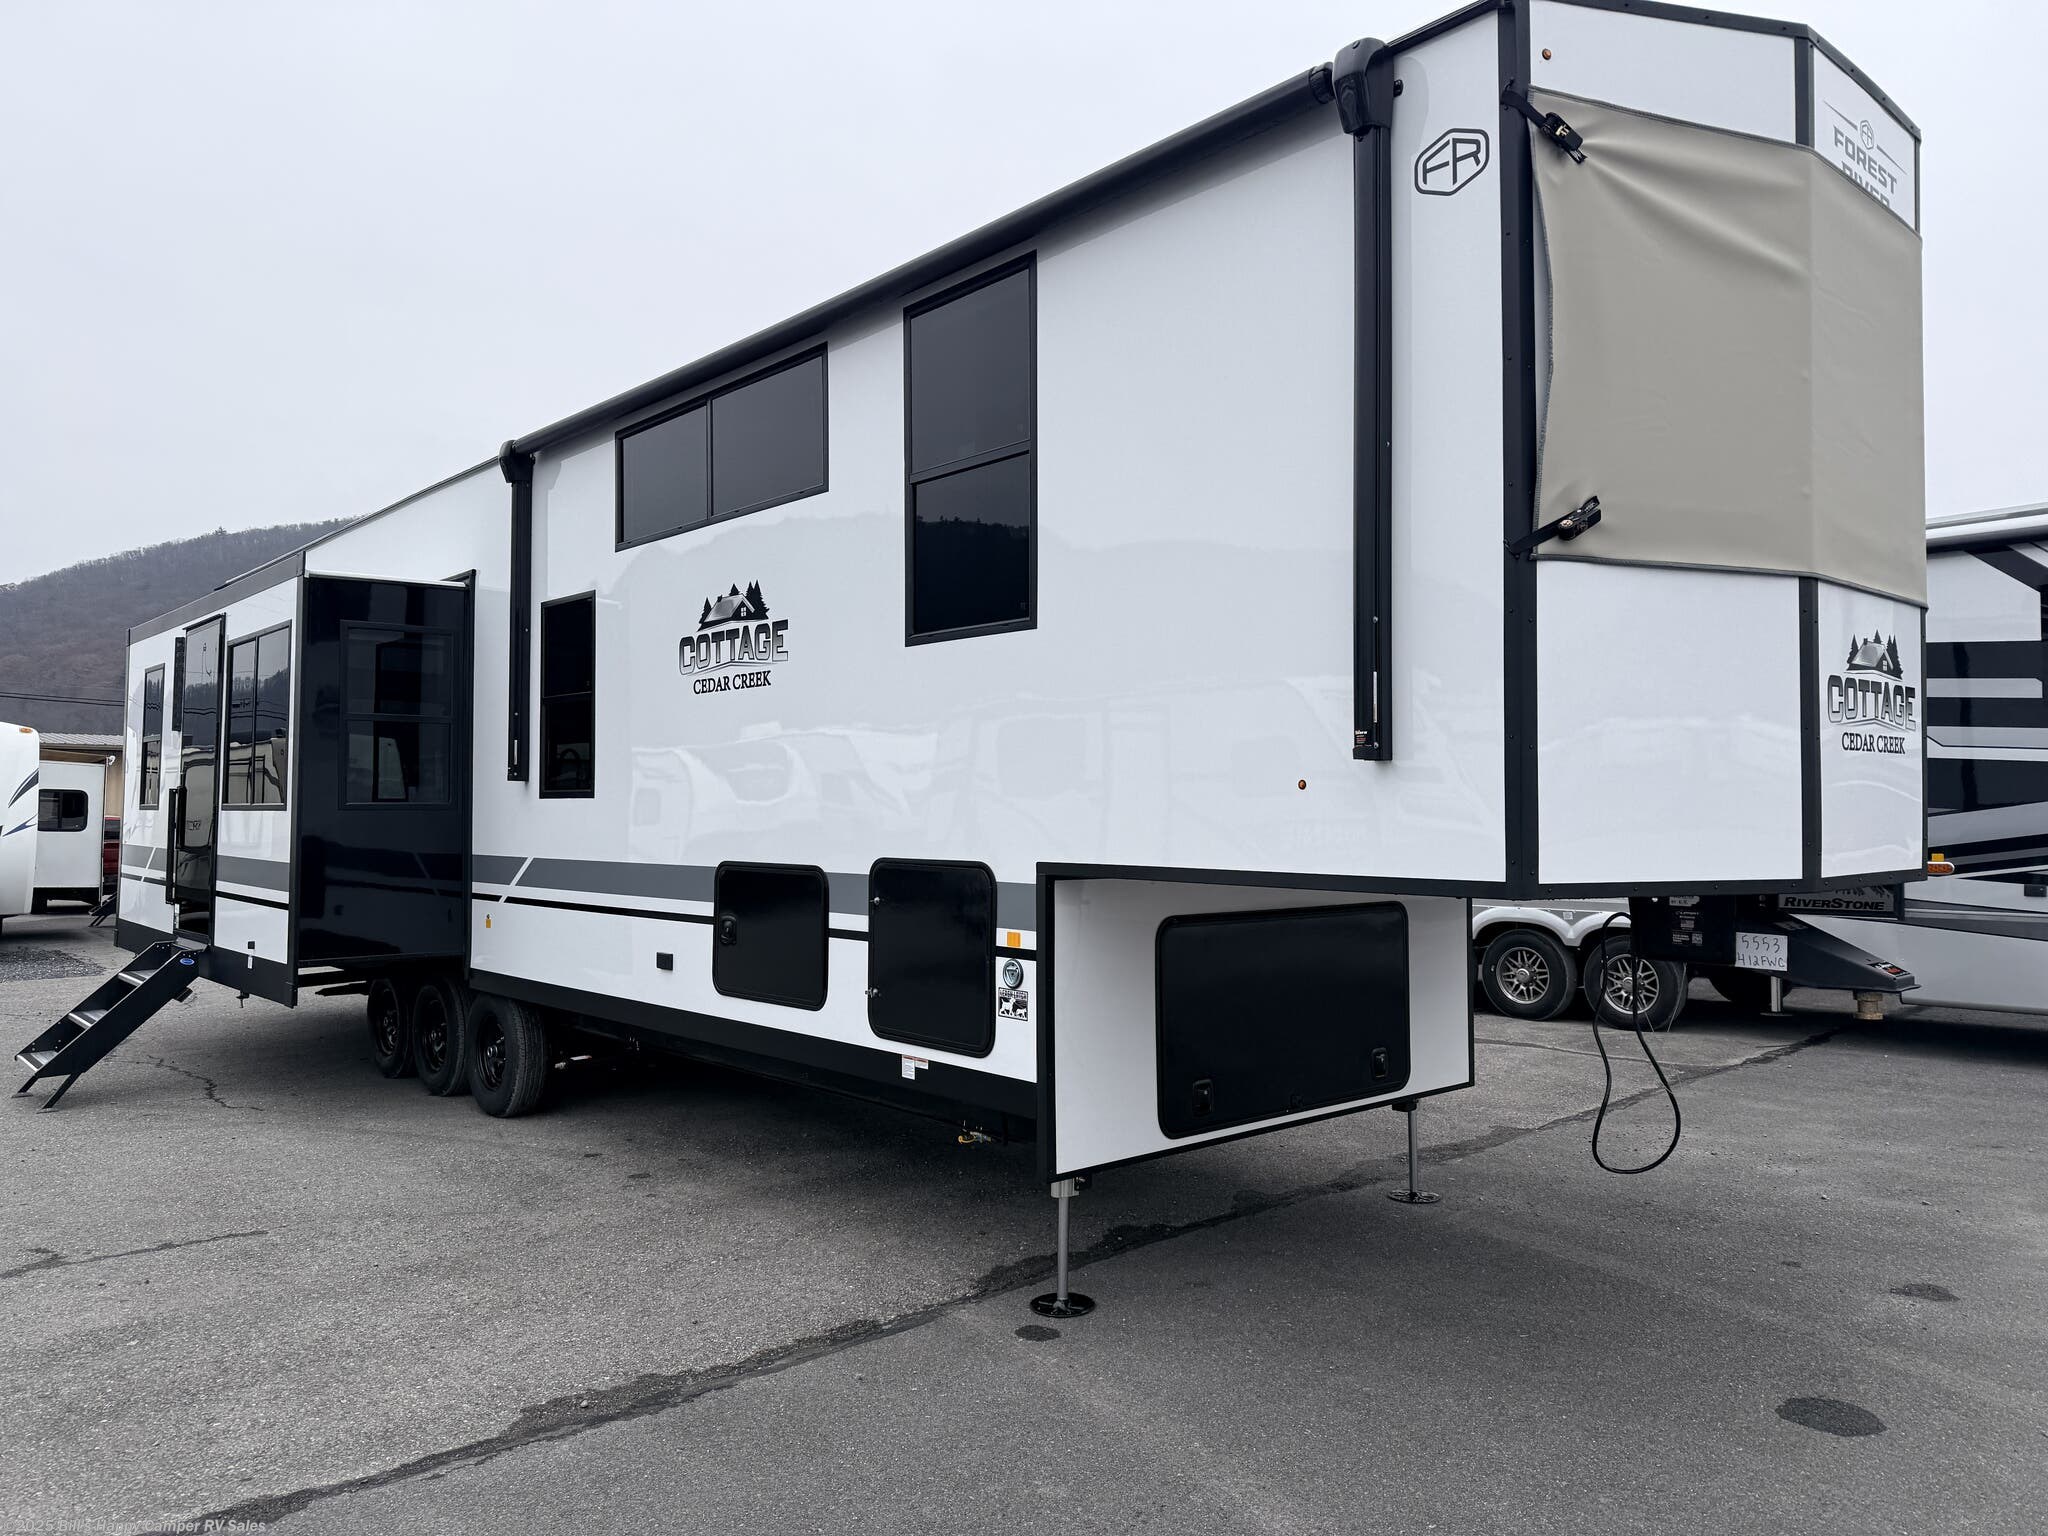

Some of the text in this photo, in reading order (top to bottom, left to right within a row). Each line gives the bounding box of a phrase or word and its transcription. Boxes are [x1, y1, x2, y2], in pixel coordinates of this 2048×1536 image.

[1421, 136, 1482, 186] FR
[1833, 124, 1898, 194] FOREST
[678, 618, 789, 675] COTTAGE
[693, 670, 771, 694] CEDAR CREEK
[1827, 674, 1917, 732] COTTAGE
[1841, 732, 1906, 754] CEDAR CREEK
[1741, 934, 1780, 953] 5553
